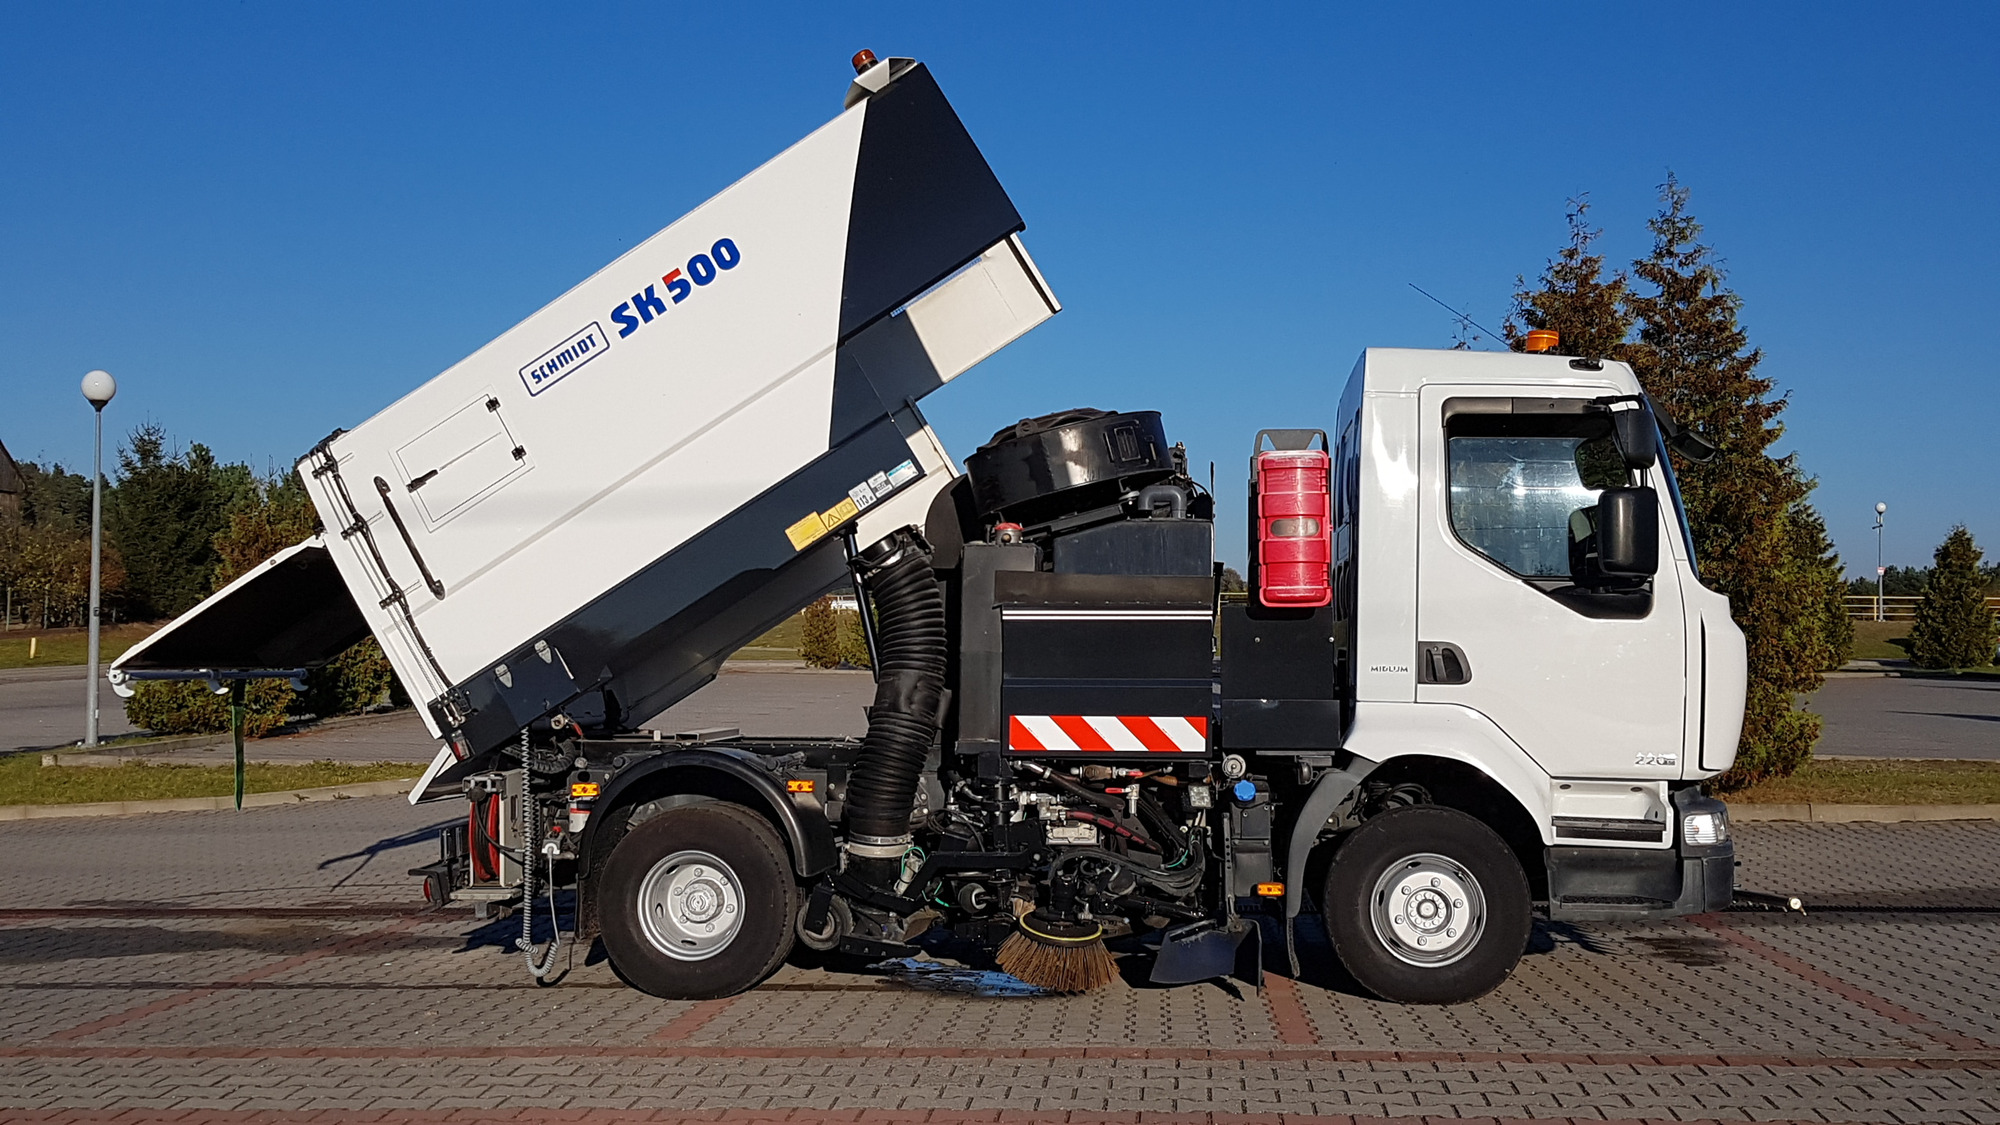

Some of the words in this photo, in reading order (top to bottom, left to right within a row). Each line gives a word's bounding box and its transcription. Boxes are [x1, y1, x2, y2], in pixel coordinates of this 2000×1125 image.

[530, 333, 597, 384] SCHMIDT
[856, 494, 870, 508] 113
[1370, 665, 1409, 673] MIDLUM
[1634, 755, 1667, 766] 220
